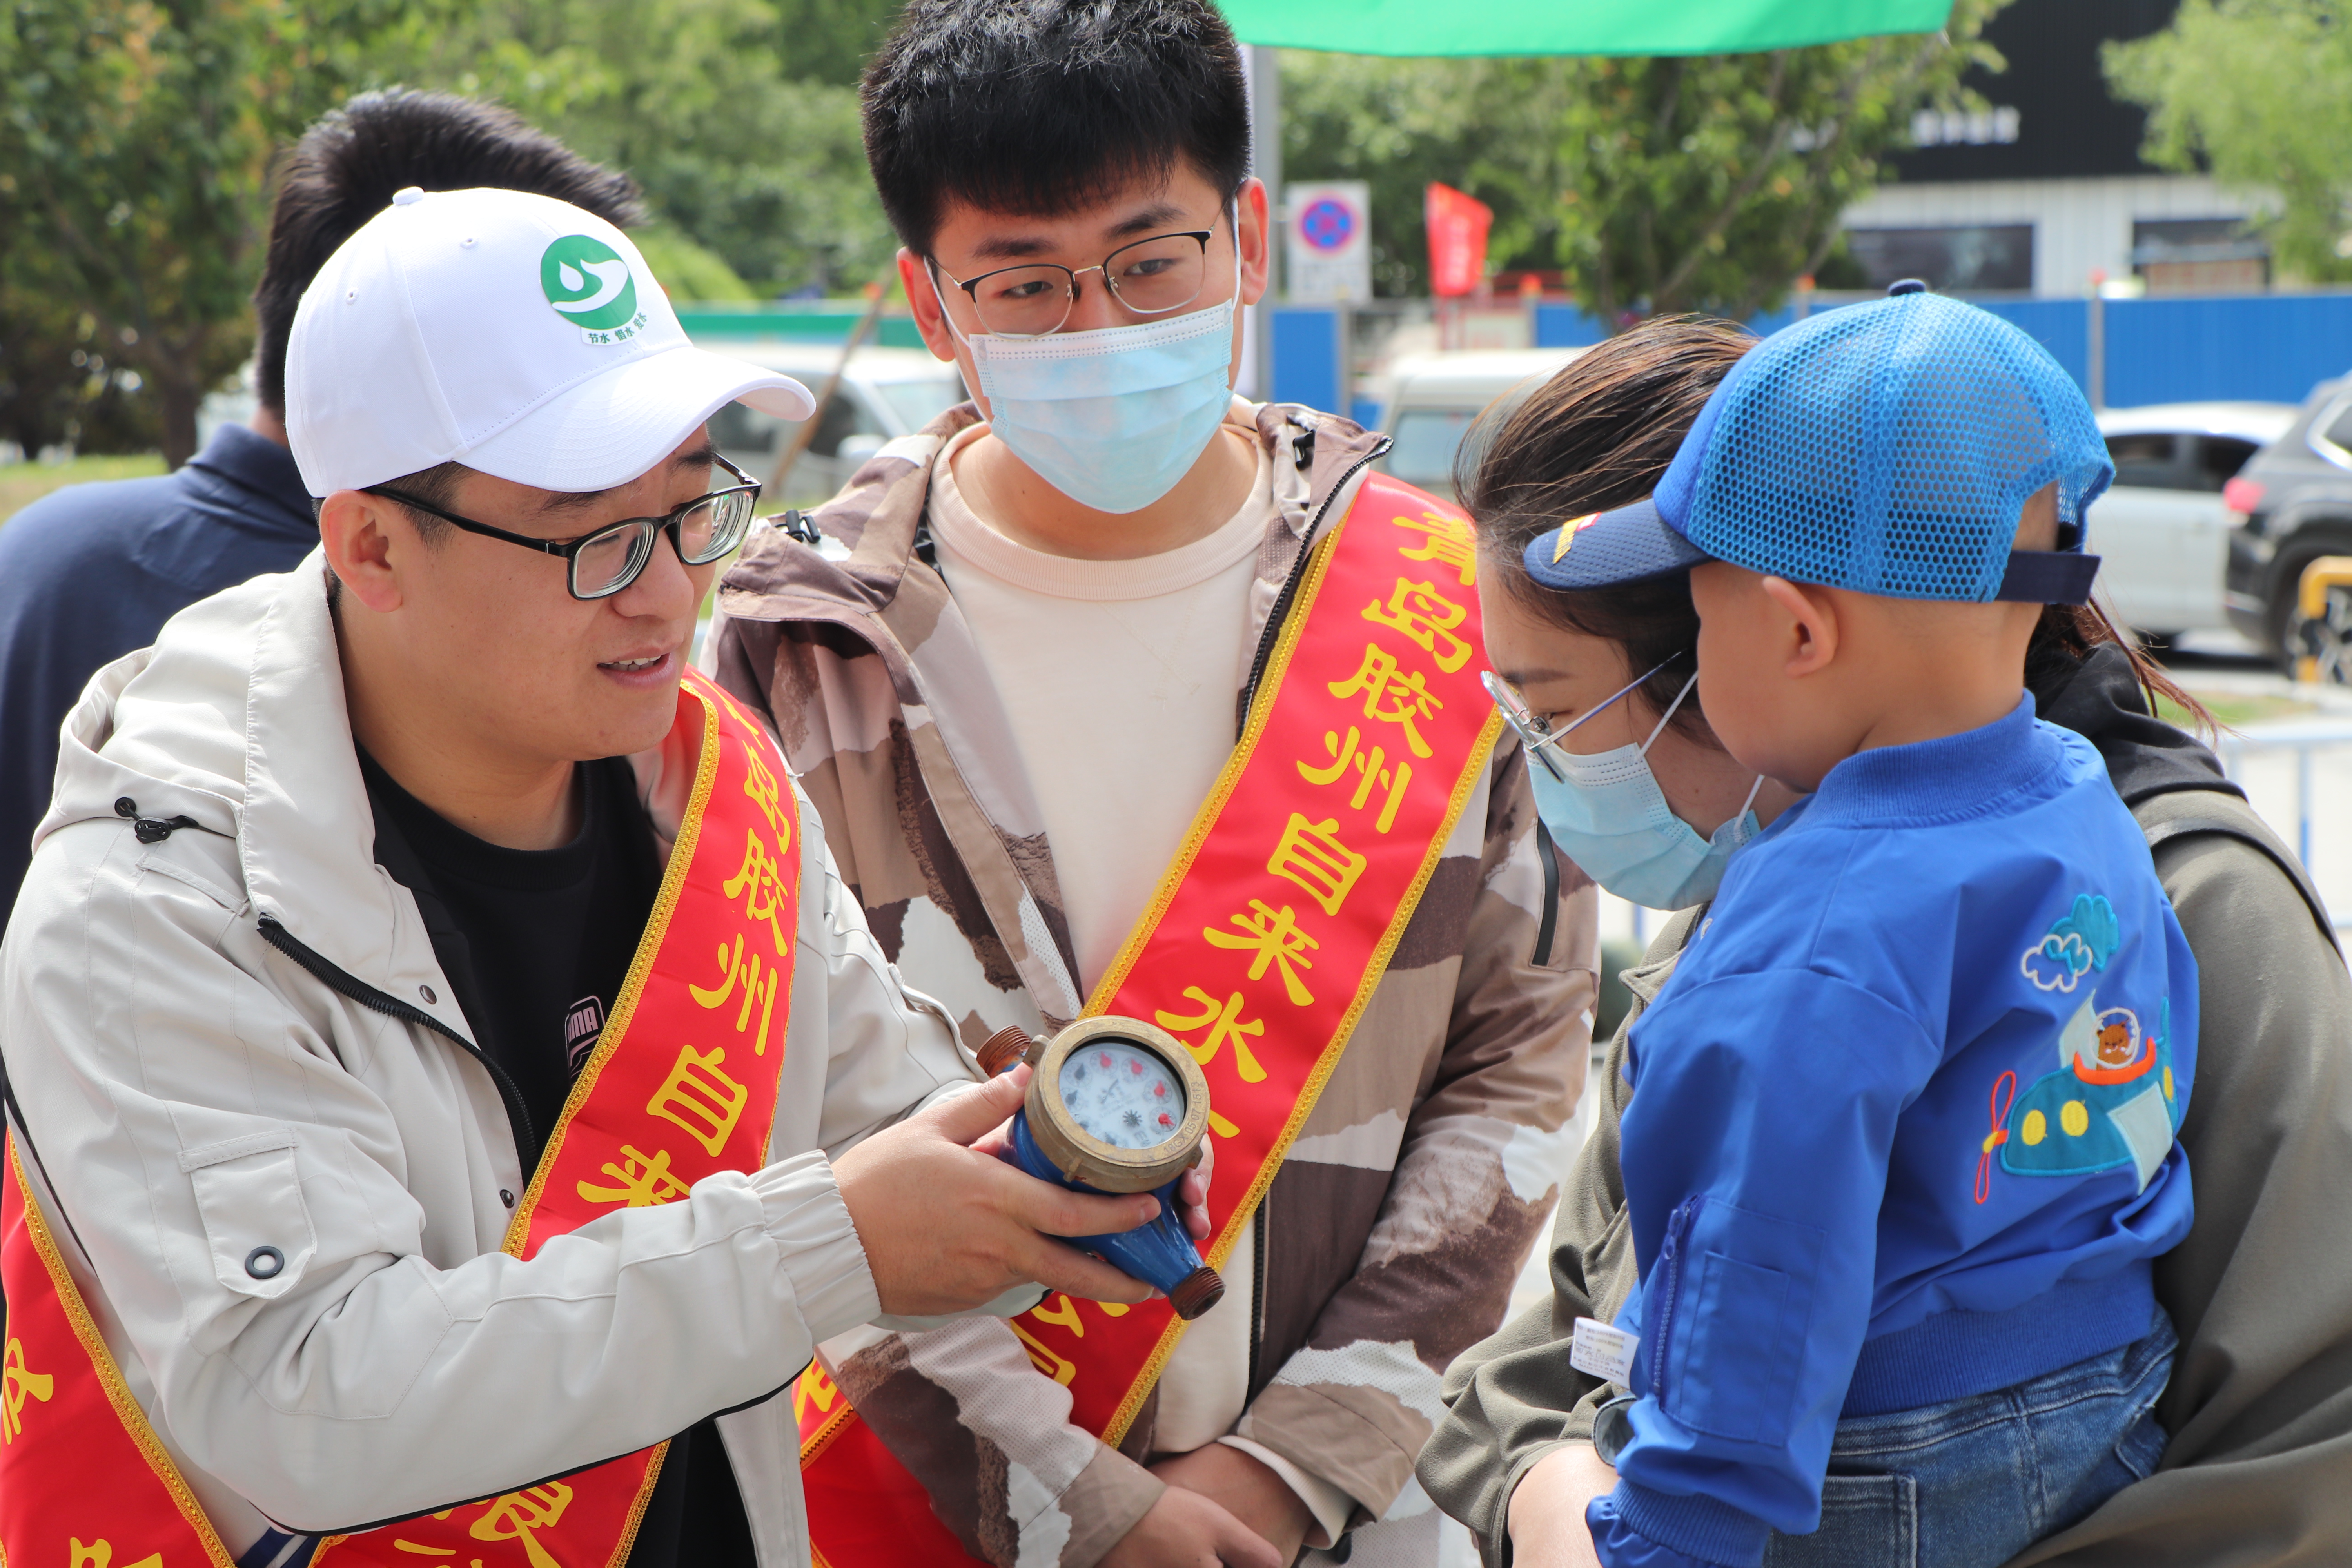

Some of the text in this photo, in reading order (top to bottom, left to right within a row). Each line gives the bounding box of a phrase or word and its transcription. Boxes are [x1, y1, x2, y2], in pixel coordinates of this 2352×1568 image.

[588, 312, 647, 344] 节水 惜水 爱水
[1155, 512, 1478, 1138] 青岛胶州自来水
